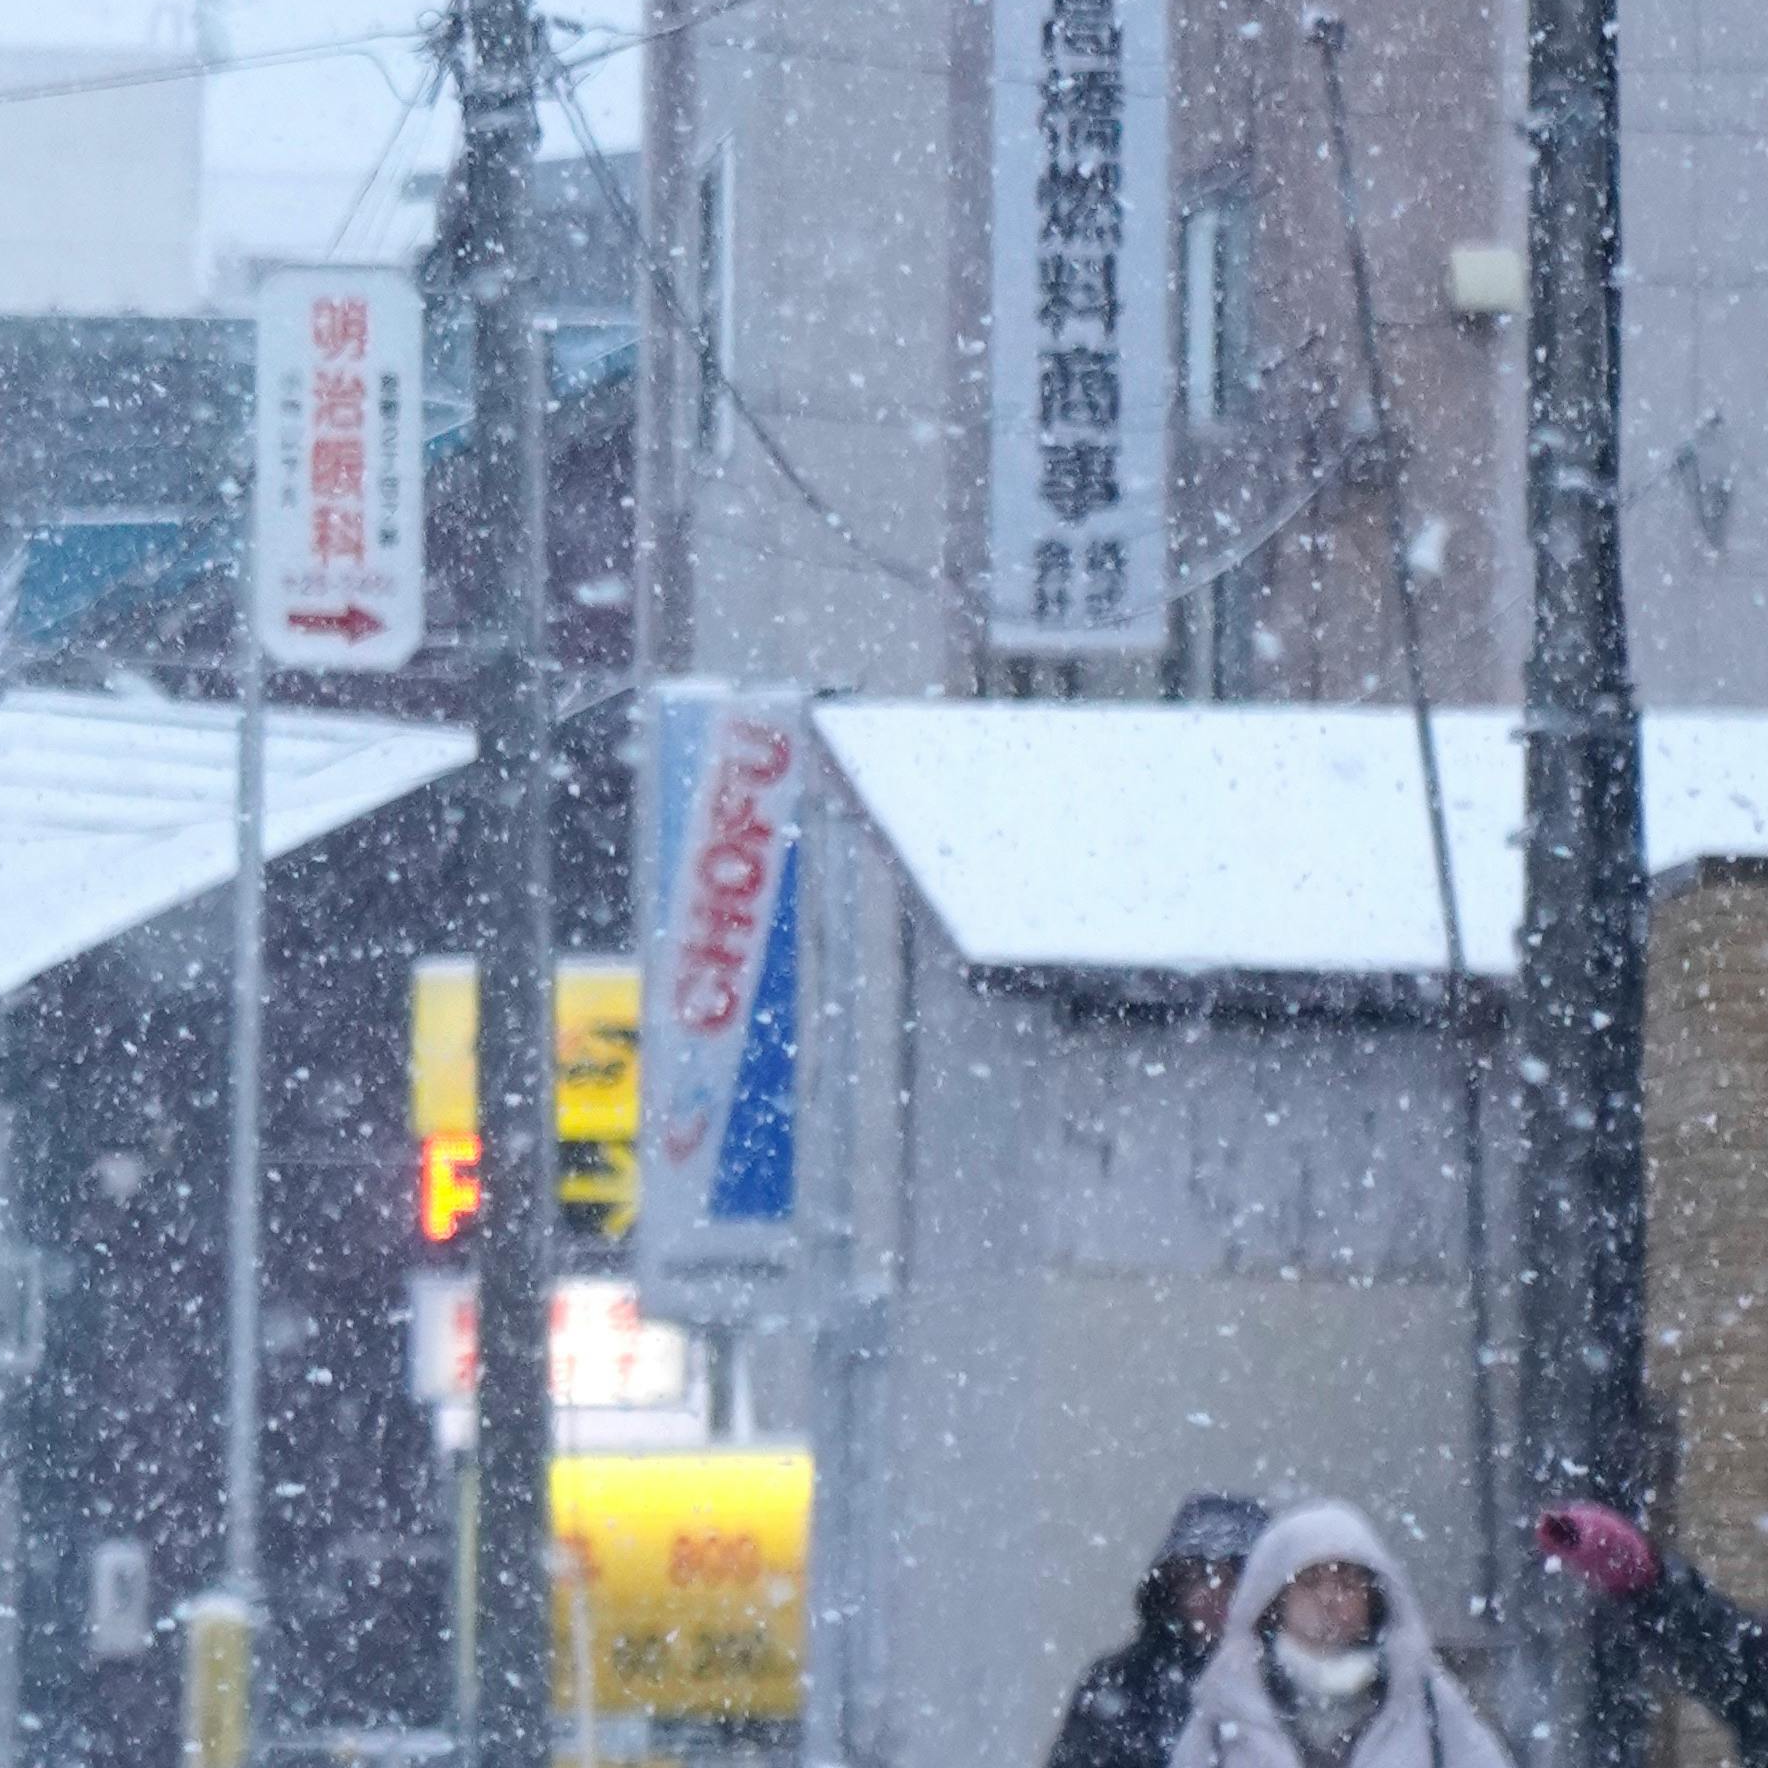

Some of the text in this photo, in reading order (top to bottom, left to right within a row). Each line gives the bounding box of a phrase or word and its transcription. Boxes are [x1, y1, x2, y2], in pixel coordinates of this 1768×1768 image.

[310, 294, 368, 569] 明治眼科
[673, 717, 793, 1038] CHOFU
